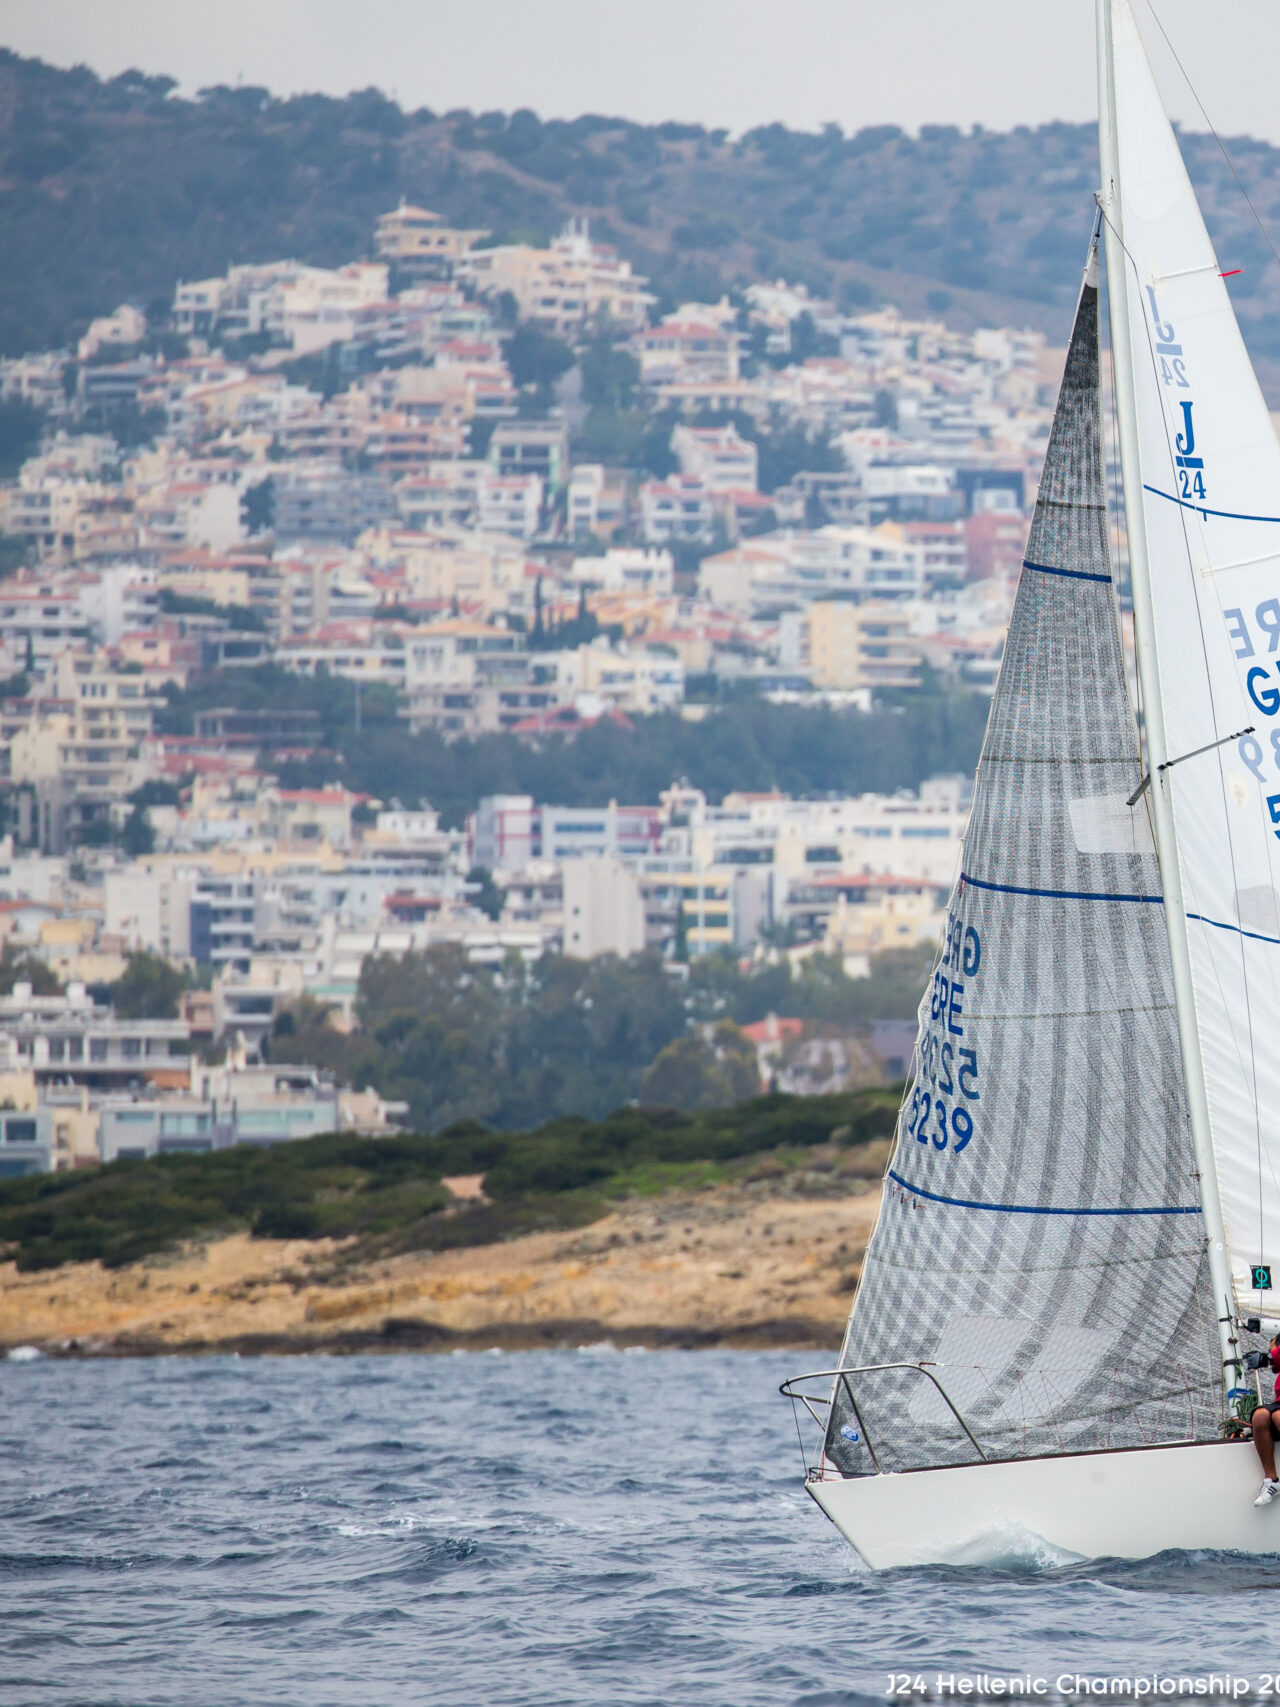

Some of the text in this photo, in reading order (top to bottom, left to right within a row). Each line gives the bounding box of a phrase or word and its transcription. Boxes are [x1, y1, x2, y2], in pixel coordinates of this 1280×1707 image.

[1175, 401, 1195, 455] J
[1178, 469, 1207, 499] 24
[931, 971, 964, 1036] GRE
[907, 1086, 974, 1154] 5239
